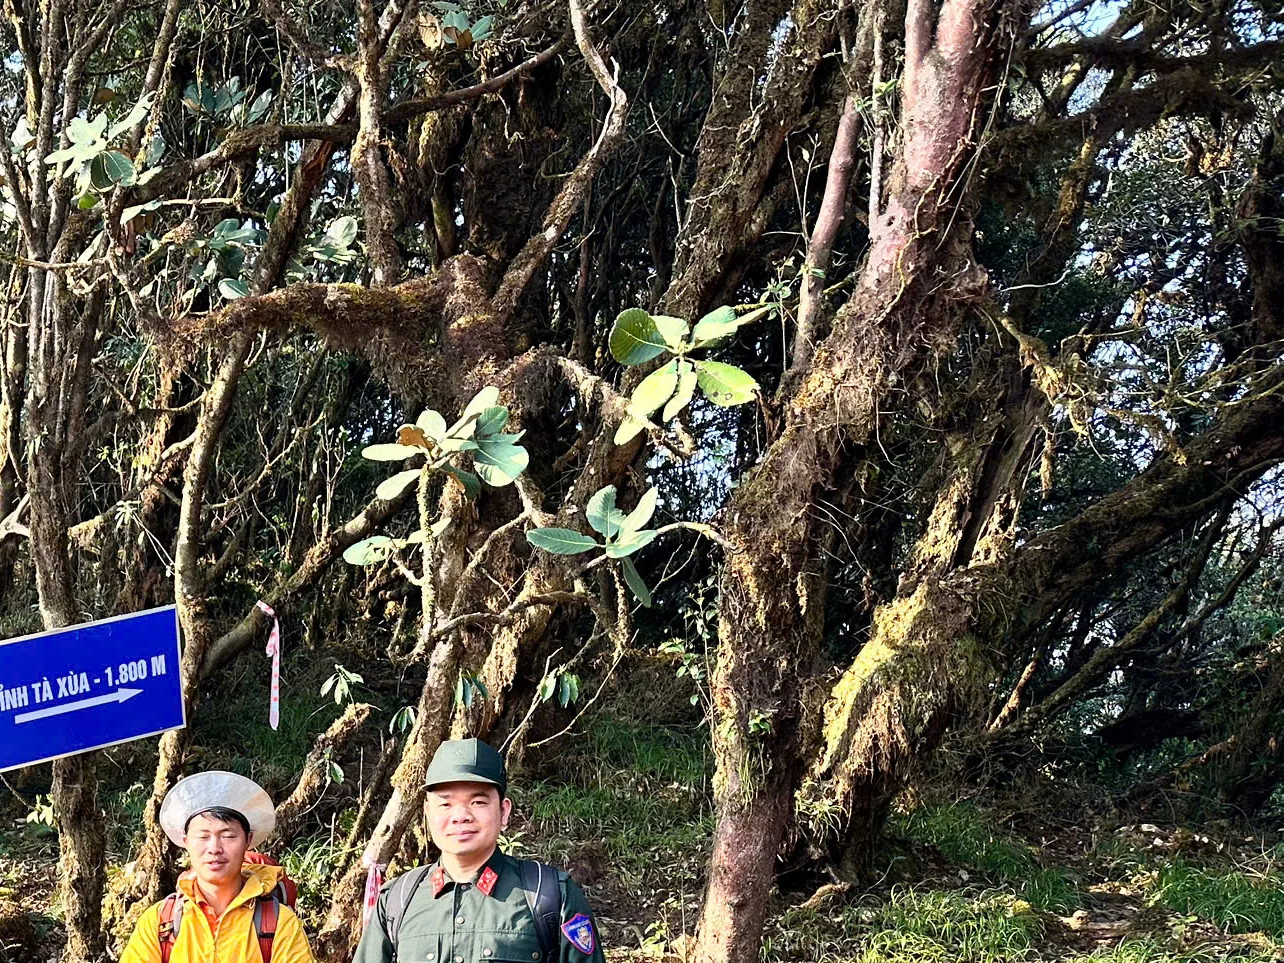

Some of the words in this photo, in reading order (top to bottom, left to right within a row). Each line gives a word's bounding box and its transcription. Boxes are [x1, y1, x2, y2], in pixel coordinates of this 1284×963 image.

[31, 677, 54, 704] TÀ
[57, 671, 91, 698] XÙA
[105, 661, 147, 687] 1.800
[151, 655, 167, 677] M
